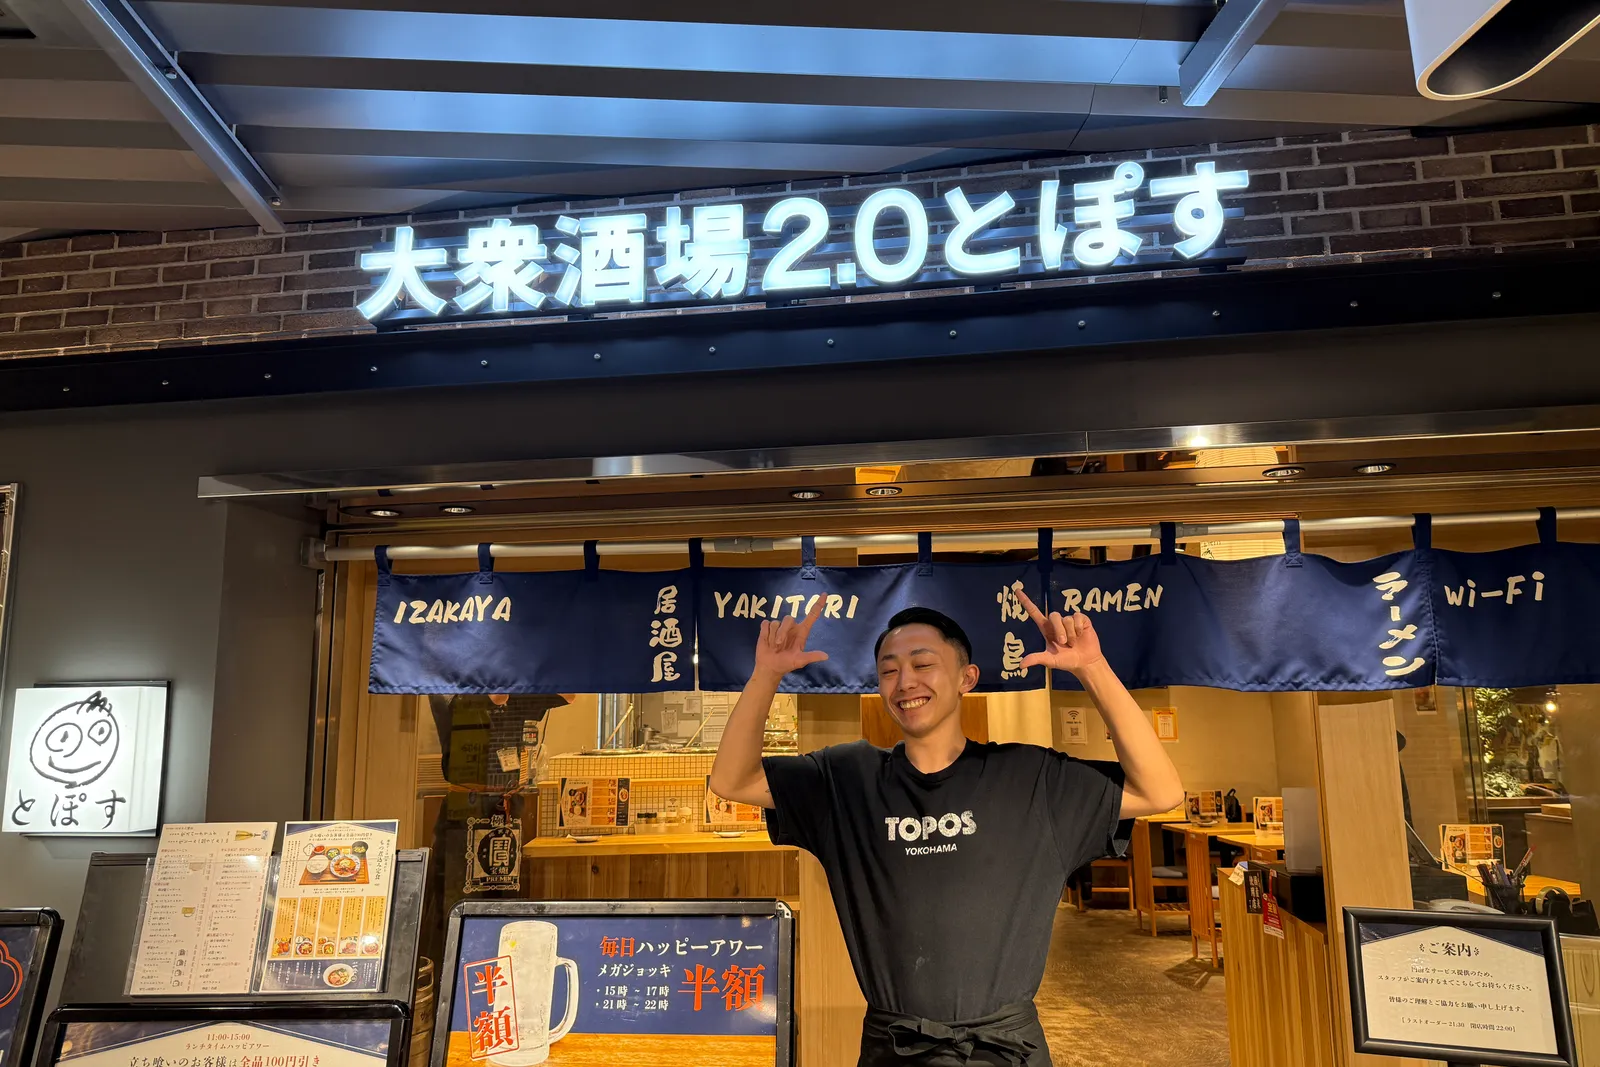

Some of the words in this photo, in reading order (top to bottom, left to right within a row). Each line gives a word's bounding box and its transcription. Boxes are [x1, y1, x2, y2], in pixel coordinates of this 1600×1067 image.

[356, 160, 1250, 322] 大衆酒場2.0とぽす
[394, 594, 512, 624] IZAKAYA
[1061, 582, 1164, 614] RAMEN
[648, 584, 683, 684] 居酒屋
[1372, 571, 1426, 677] ラーメン
[11, 788, 127, 828] とぽす
[884, 809, 978, 842] TOPOS
[904, 842, 958, 856] YOKOHAMA
[599, 935, 763, 958] 毎日ハッピーアワー
[1429, 941, 1472, 958] ご案内
[597, 963, 672, 978] メガジョッキ
[677, 963, 766, 1013] 半額
[471, 963, 515, 1052] 半額
[206, 1033, 251, 1041] 11:00-15:00
[129, 1055, 321, 1067] 立ち喰いのお客様は全品100円引き
